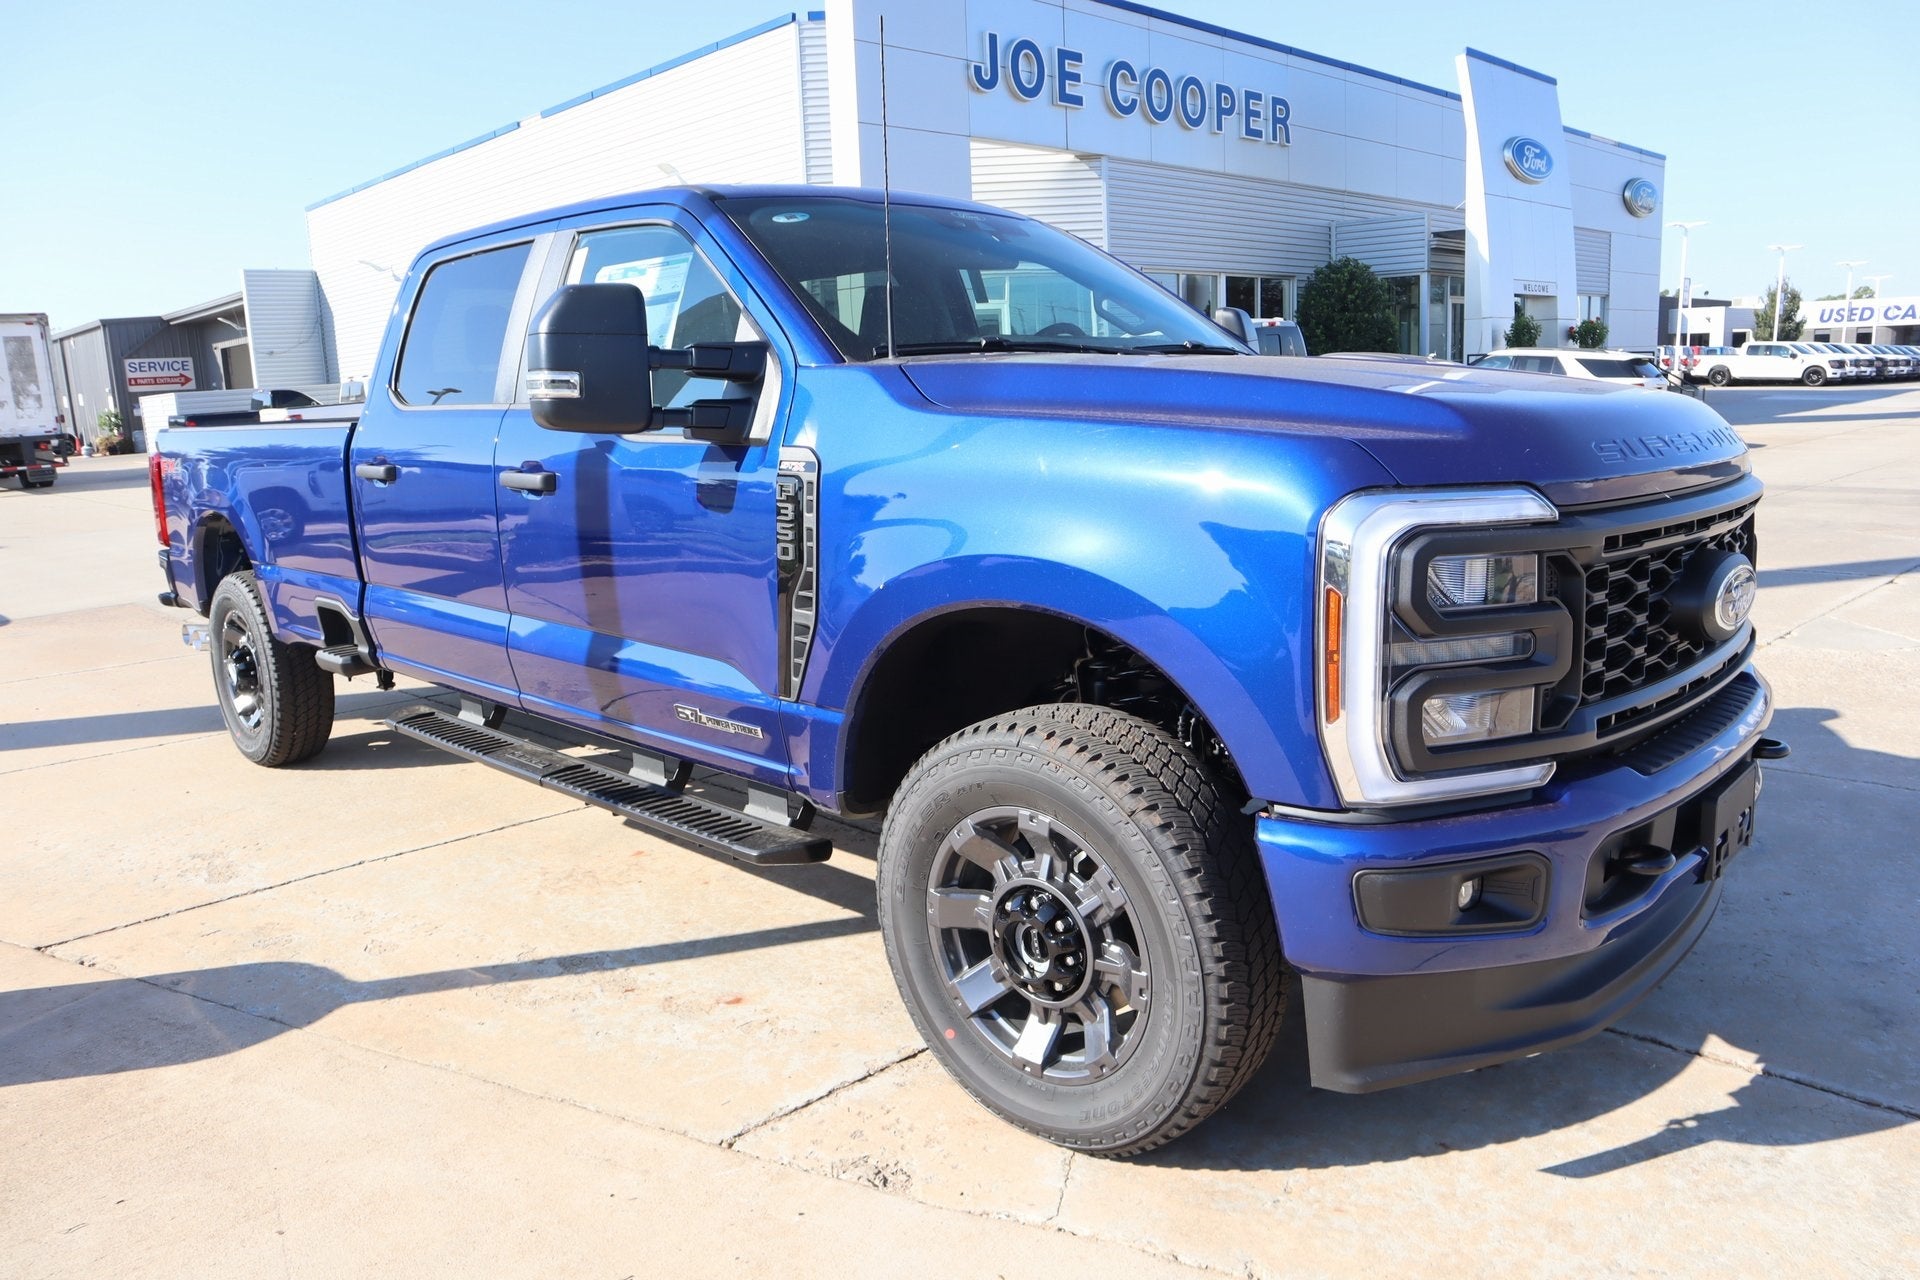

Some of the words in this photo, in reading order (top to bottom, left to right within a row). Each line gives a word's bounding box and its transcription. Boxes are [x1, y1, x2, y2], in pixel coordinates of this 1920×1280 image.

[971, 32, 1085, 108] JOE
[1106, 59, 1292, 146] COOPER
[1523, 145, 1547, 173] Ford
[1523, 283, 1549, 293] WELCOME
[1819, 306, 1875, 323] USED
[1883, 304, 1920, 321] CA
[128, 360, 190, 373] SERVICE
[1592, 431, 1708, 464] SUPER
[776, 483, 795, 560] F350
[674, 704, 707, 726] 6.7L
[706, 716, 731, 730] POWER
[731, 723, 760, 736] STROKE
